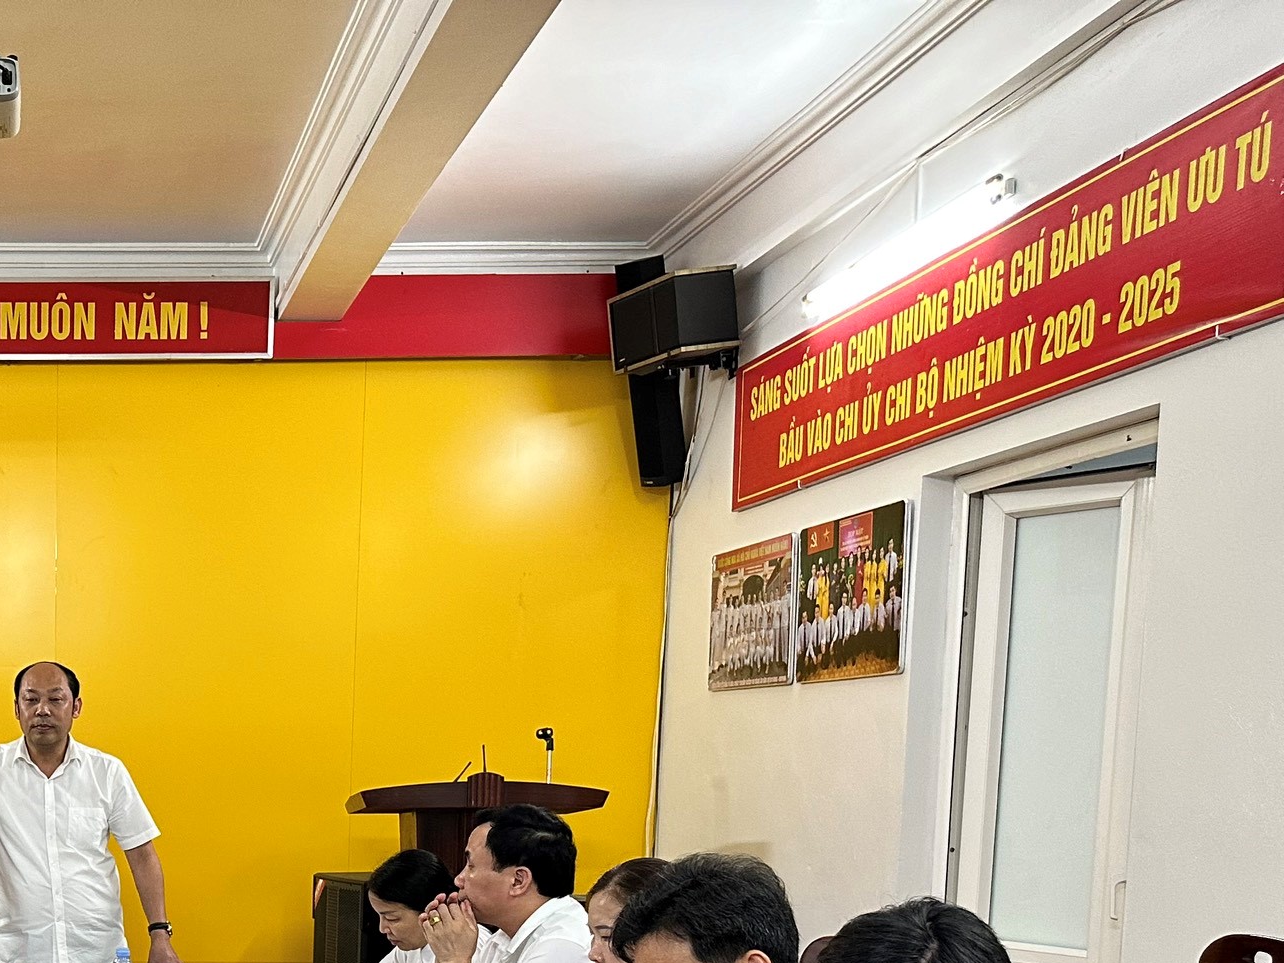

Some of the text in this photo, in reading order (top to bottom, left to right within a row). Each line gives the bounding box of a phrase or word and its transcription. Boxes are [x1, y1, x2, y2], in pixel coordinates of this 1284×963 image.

[0, 292, 95, 341] MUÔN
[114, 292, 188, 341] NĂM
[199, 301, 209, 339] !
[750, 110, 1273, 421] SÁNG SUỐT LỰA CHỌN NHỮNG ĐỒNG CHÍ ĐẢNG VIÊN ƯU TÚ
[778, 260, 1181, 469] BẦU VÀO CHI ỦY CHI BỘ NHIỆM KỲ 2020 - 2025
